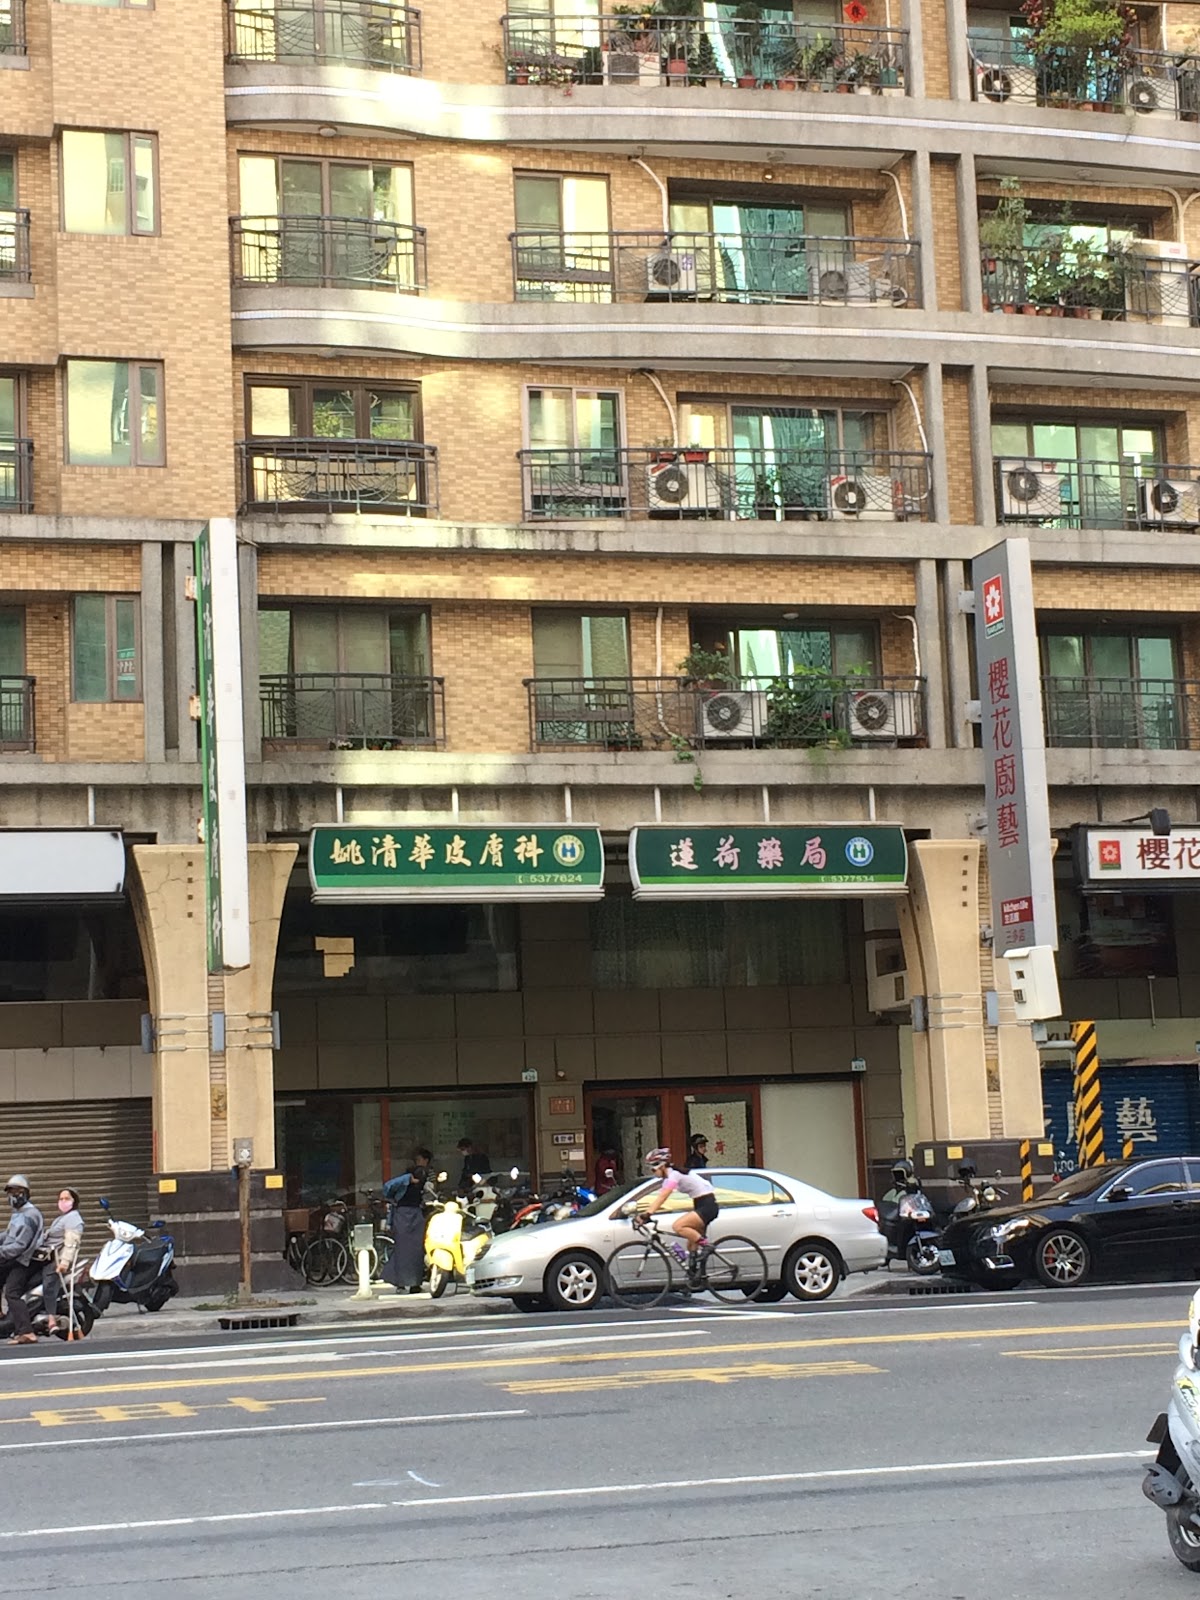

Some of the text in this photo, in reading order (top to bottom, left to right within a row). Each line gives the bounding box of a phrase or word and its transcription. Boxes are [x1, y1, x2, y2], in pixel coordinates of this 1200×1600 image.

[988, 657, 1020, 848] 櫻花廚藝
[329, 833, 544, 870] 姚清華皮膚科
[670, 835, 827, 870] 蓮荷藥局
[1136, 837, 1200, 870] 櫻花
